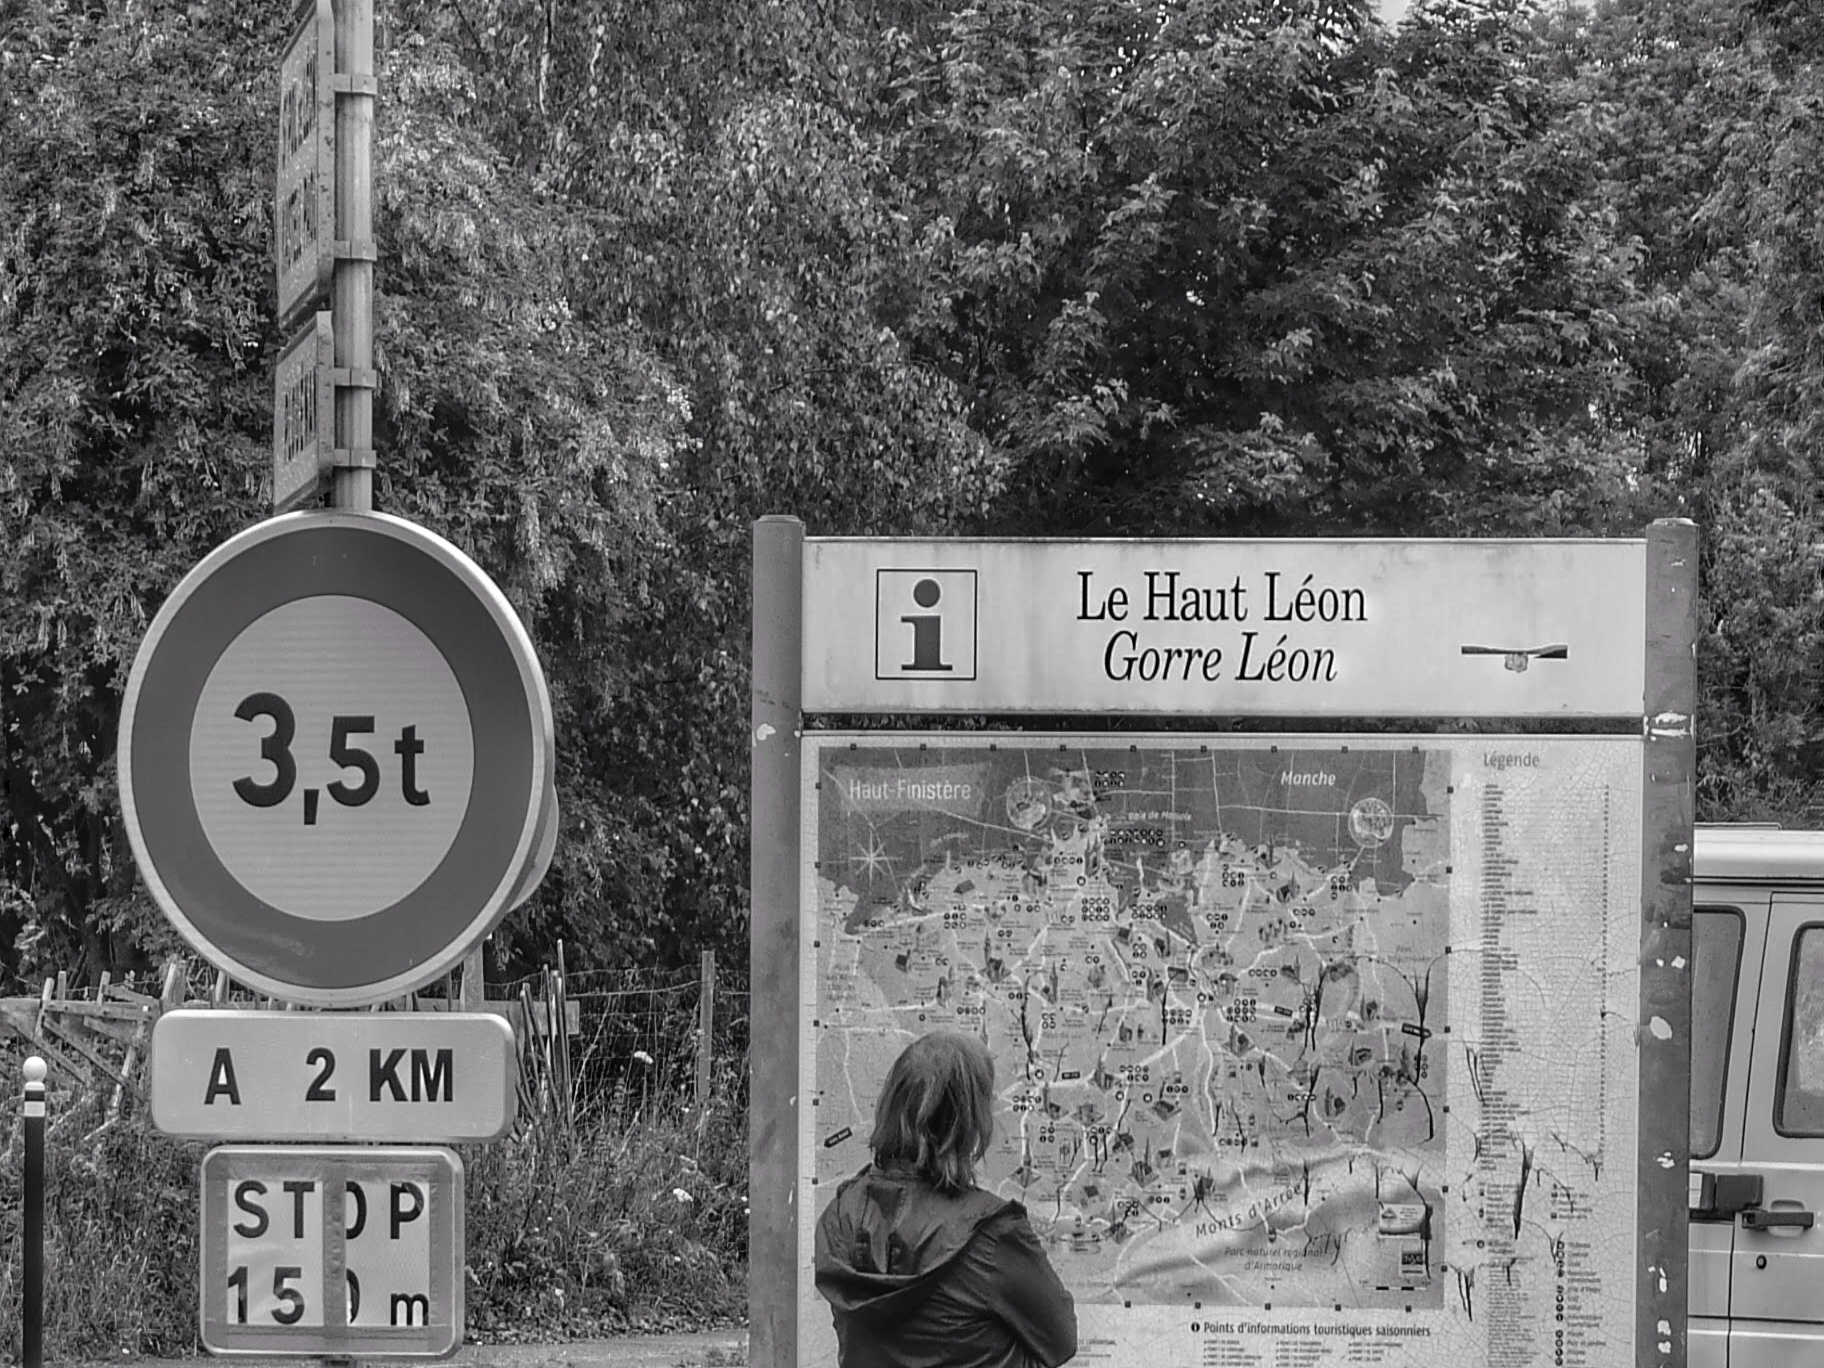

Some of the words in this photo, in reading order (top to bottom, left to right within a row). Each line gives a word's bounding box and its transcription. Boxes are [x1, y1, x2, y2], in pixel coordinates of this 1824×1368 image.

[1076, 571, 1129, 621] Le
[1143, 571, 1248, 622] Haut
[1264, 572, 1368, 622] Léon
[1104, 631, 1222, 682] Gorre
[1234, 632, 1337, 682] Léon
[1483, 752, 1540, 771] Légende
[849, 779, 971, 800] Haut-Finistère
[1280, 770, 1336, 786] Manche
[204, 1048, 241, 1105] A
[305, 1047, 336, 1102] 2
[369, 1048, 453, 1103] KM
[1195, 1213, 1242, 1239] Monts
[1224, 1245, 1245, 1257] Parc
[390, 1293, 429, 1326] m
[1203, 1321, 1234, 1334] Points
[1237, 1321, 1311, 1335] d'informations
[1313, 1323, 1373, 1338] touristiques
[1375, 1325, 1431, 1337] saisonniers
